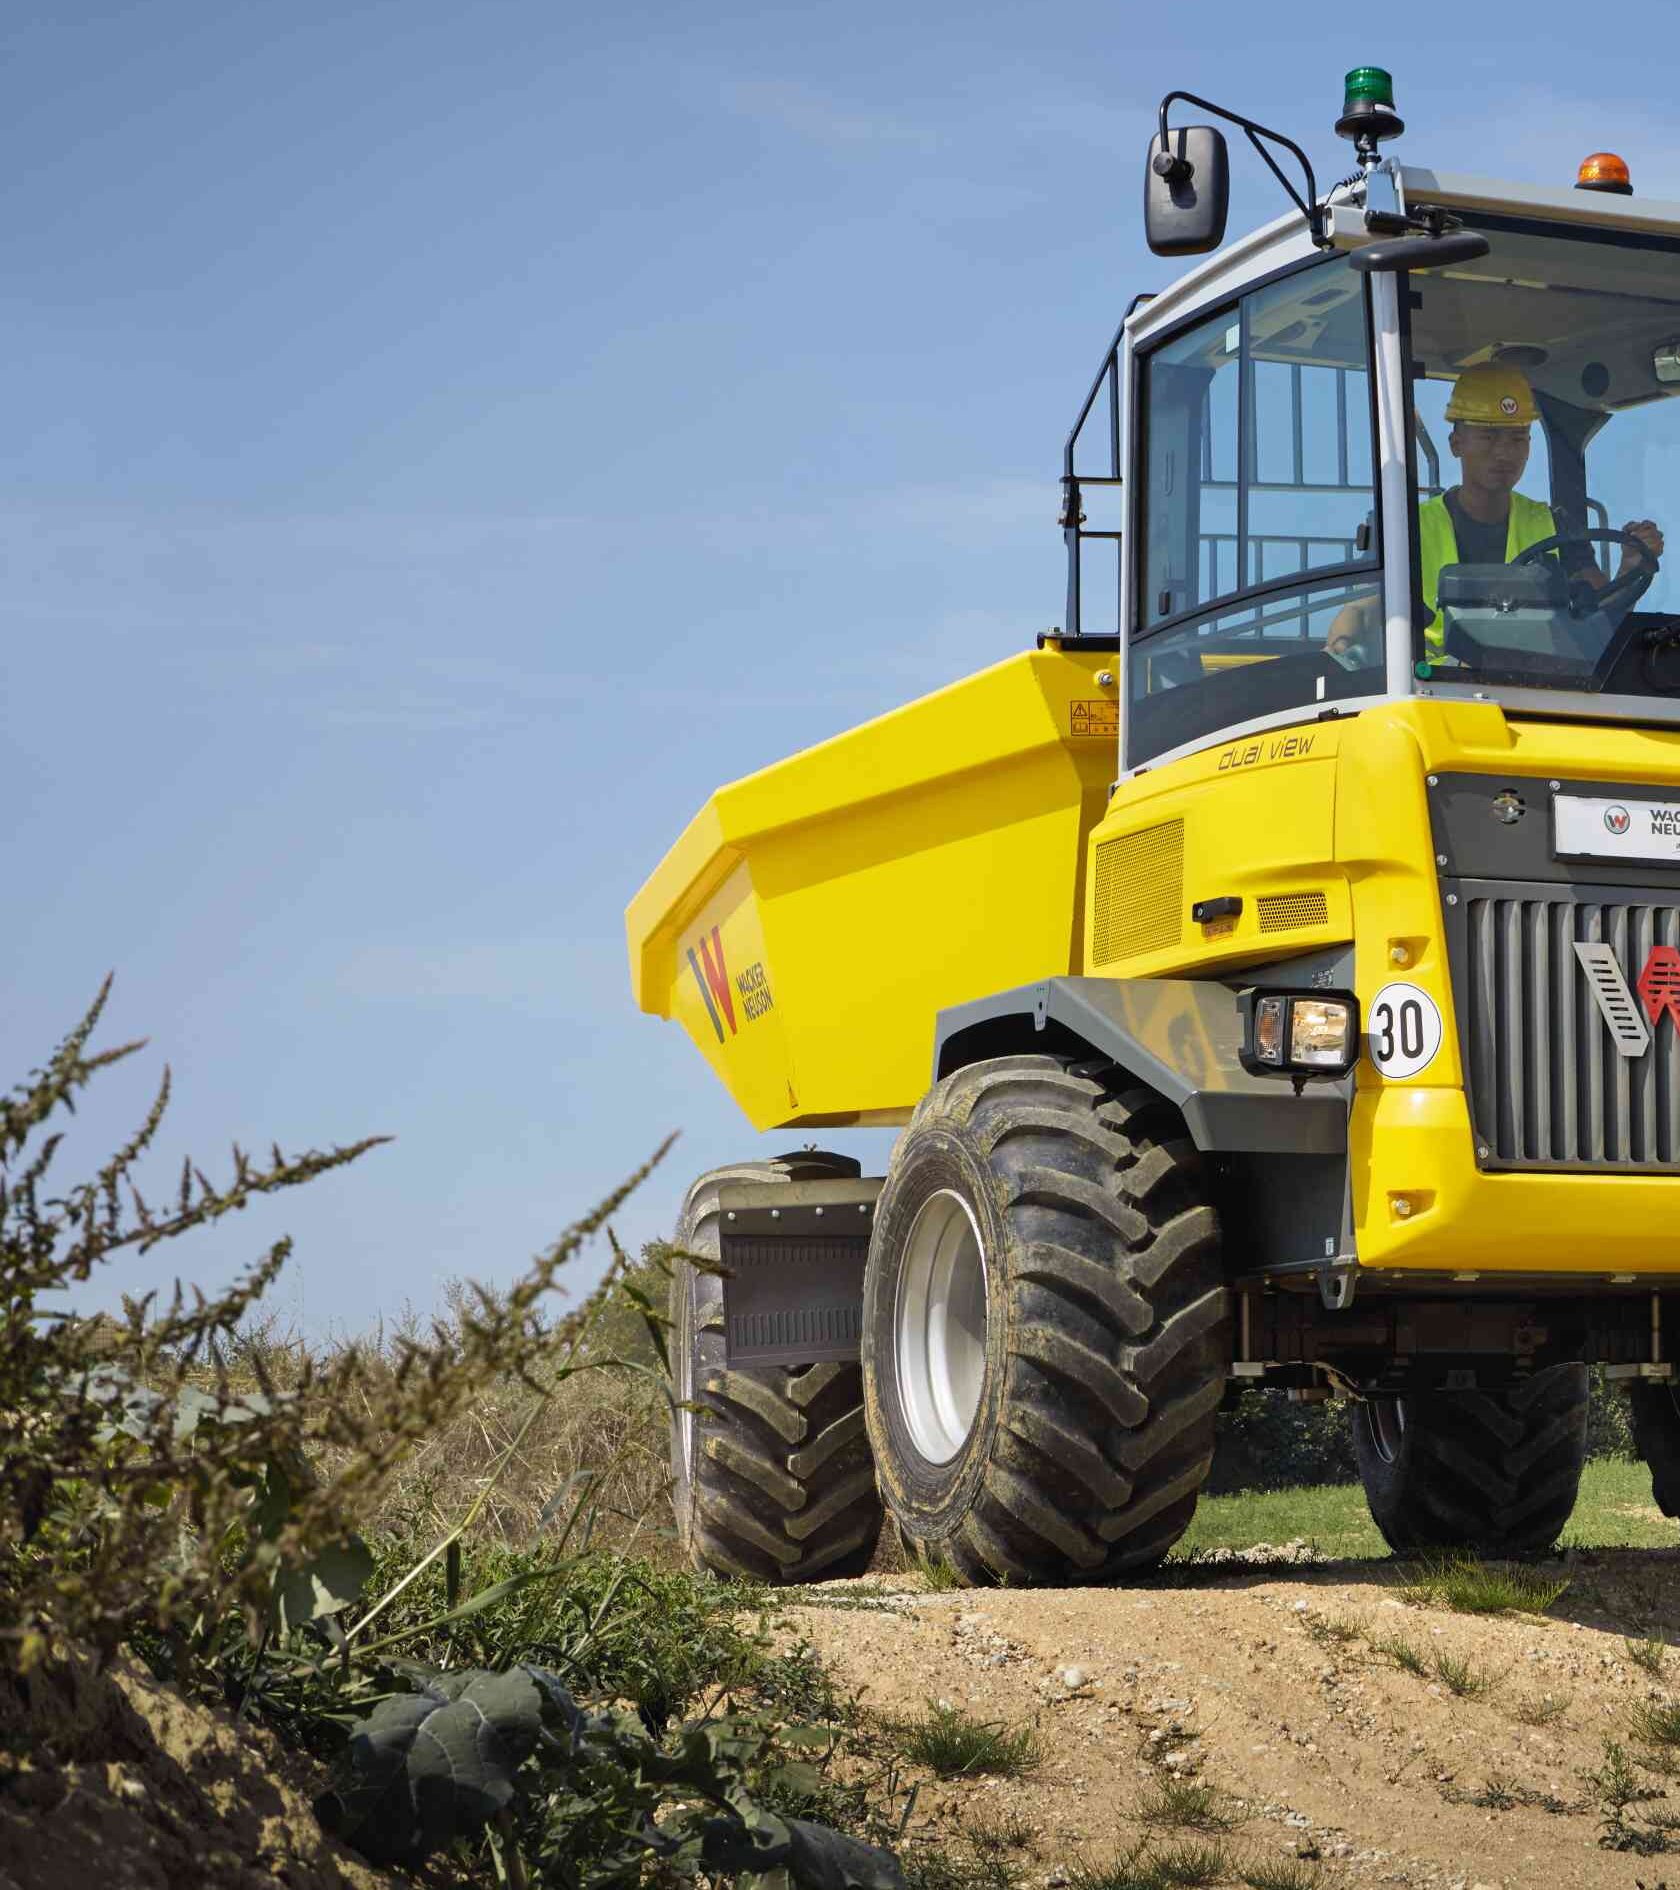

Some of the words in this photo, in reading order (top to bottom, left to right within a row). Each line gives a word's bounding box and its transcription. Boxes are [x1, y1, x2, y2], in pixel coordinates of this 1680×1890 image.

[1218, 741, 1264, 771] dual
[1270, 734, 1316, 760] view
[736, 962, 768, 997] WACKER
[743, 986, 774, 1022] NEUSON
[1376, 999, 1424, 1063] 30
